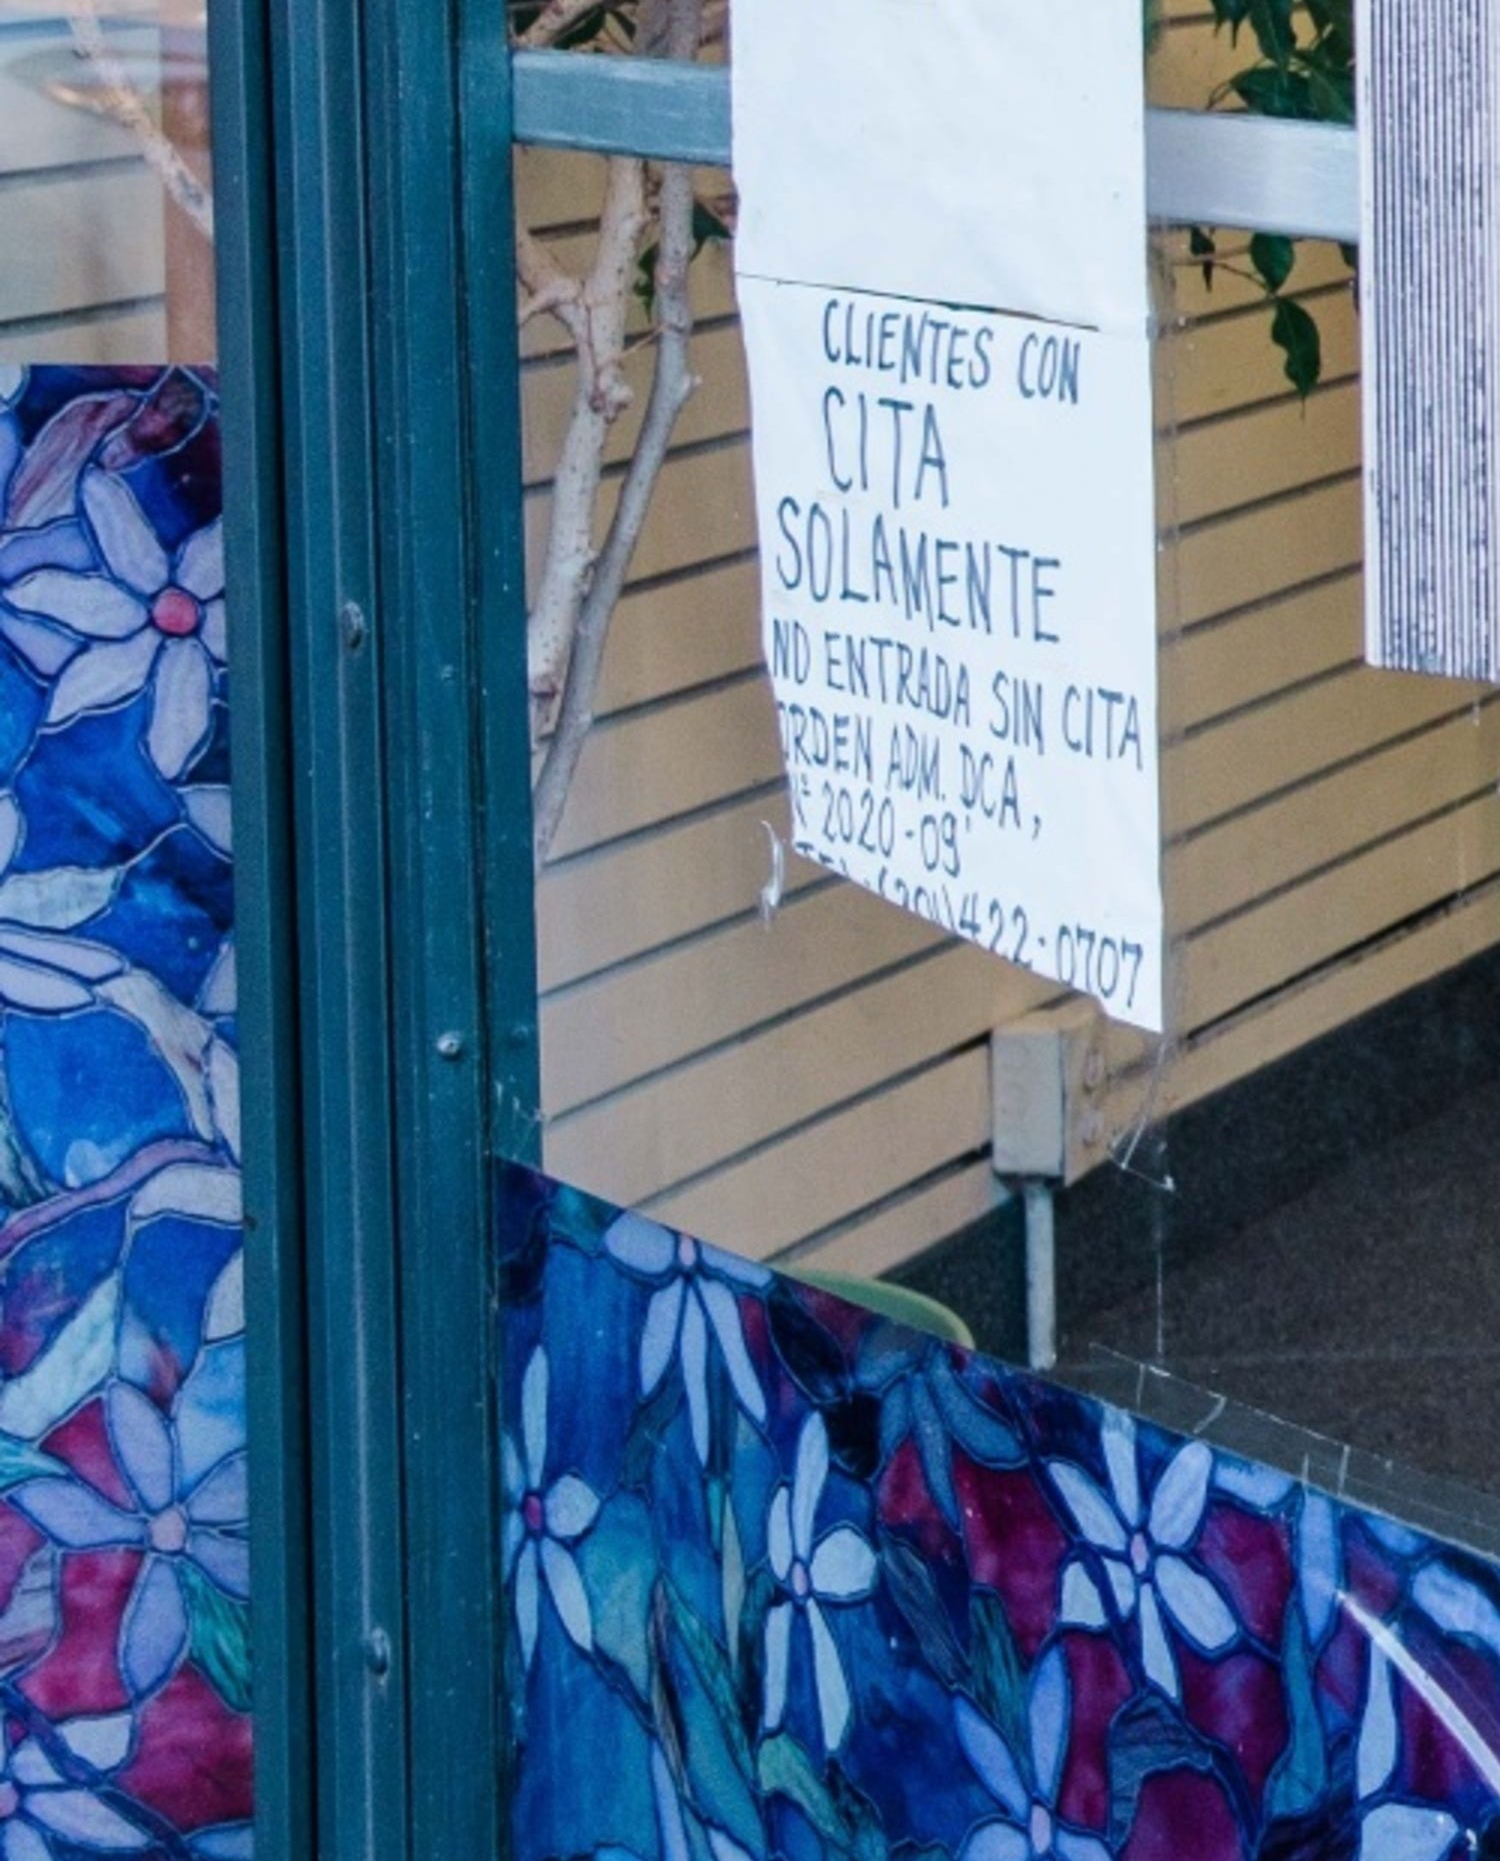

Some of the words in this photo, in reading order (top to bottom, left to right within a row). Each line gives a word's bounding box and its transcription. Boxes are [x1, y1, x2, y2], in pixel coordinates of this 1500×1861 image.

[822, 299, 993, 391] CLIENTES
[1019, 332, 1080, 404] CON
[823, 387, 949, 509] CITA
[776, 496, 1061, 643] SOLAMENTE
[772, 618, 811, 684] NO
[824, 631, 970, 728] ENTRADA
[989, 669, 1044, 756] SIN
[1062, 684, 1143, 771] CITA
[886, 723, 946, 801] ADM.
